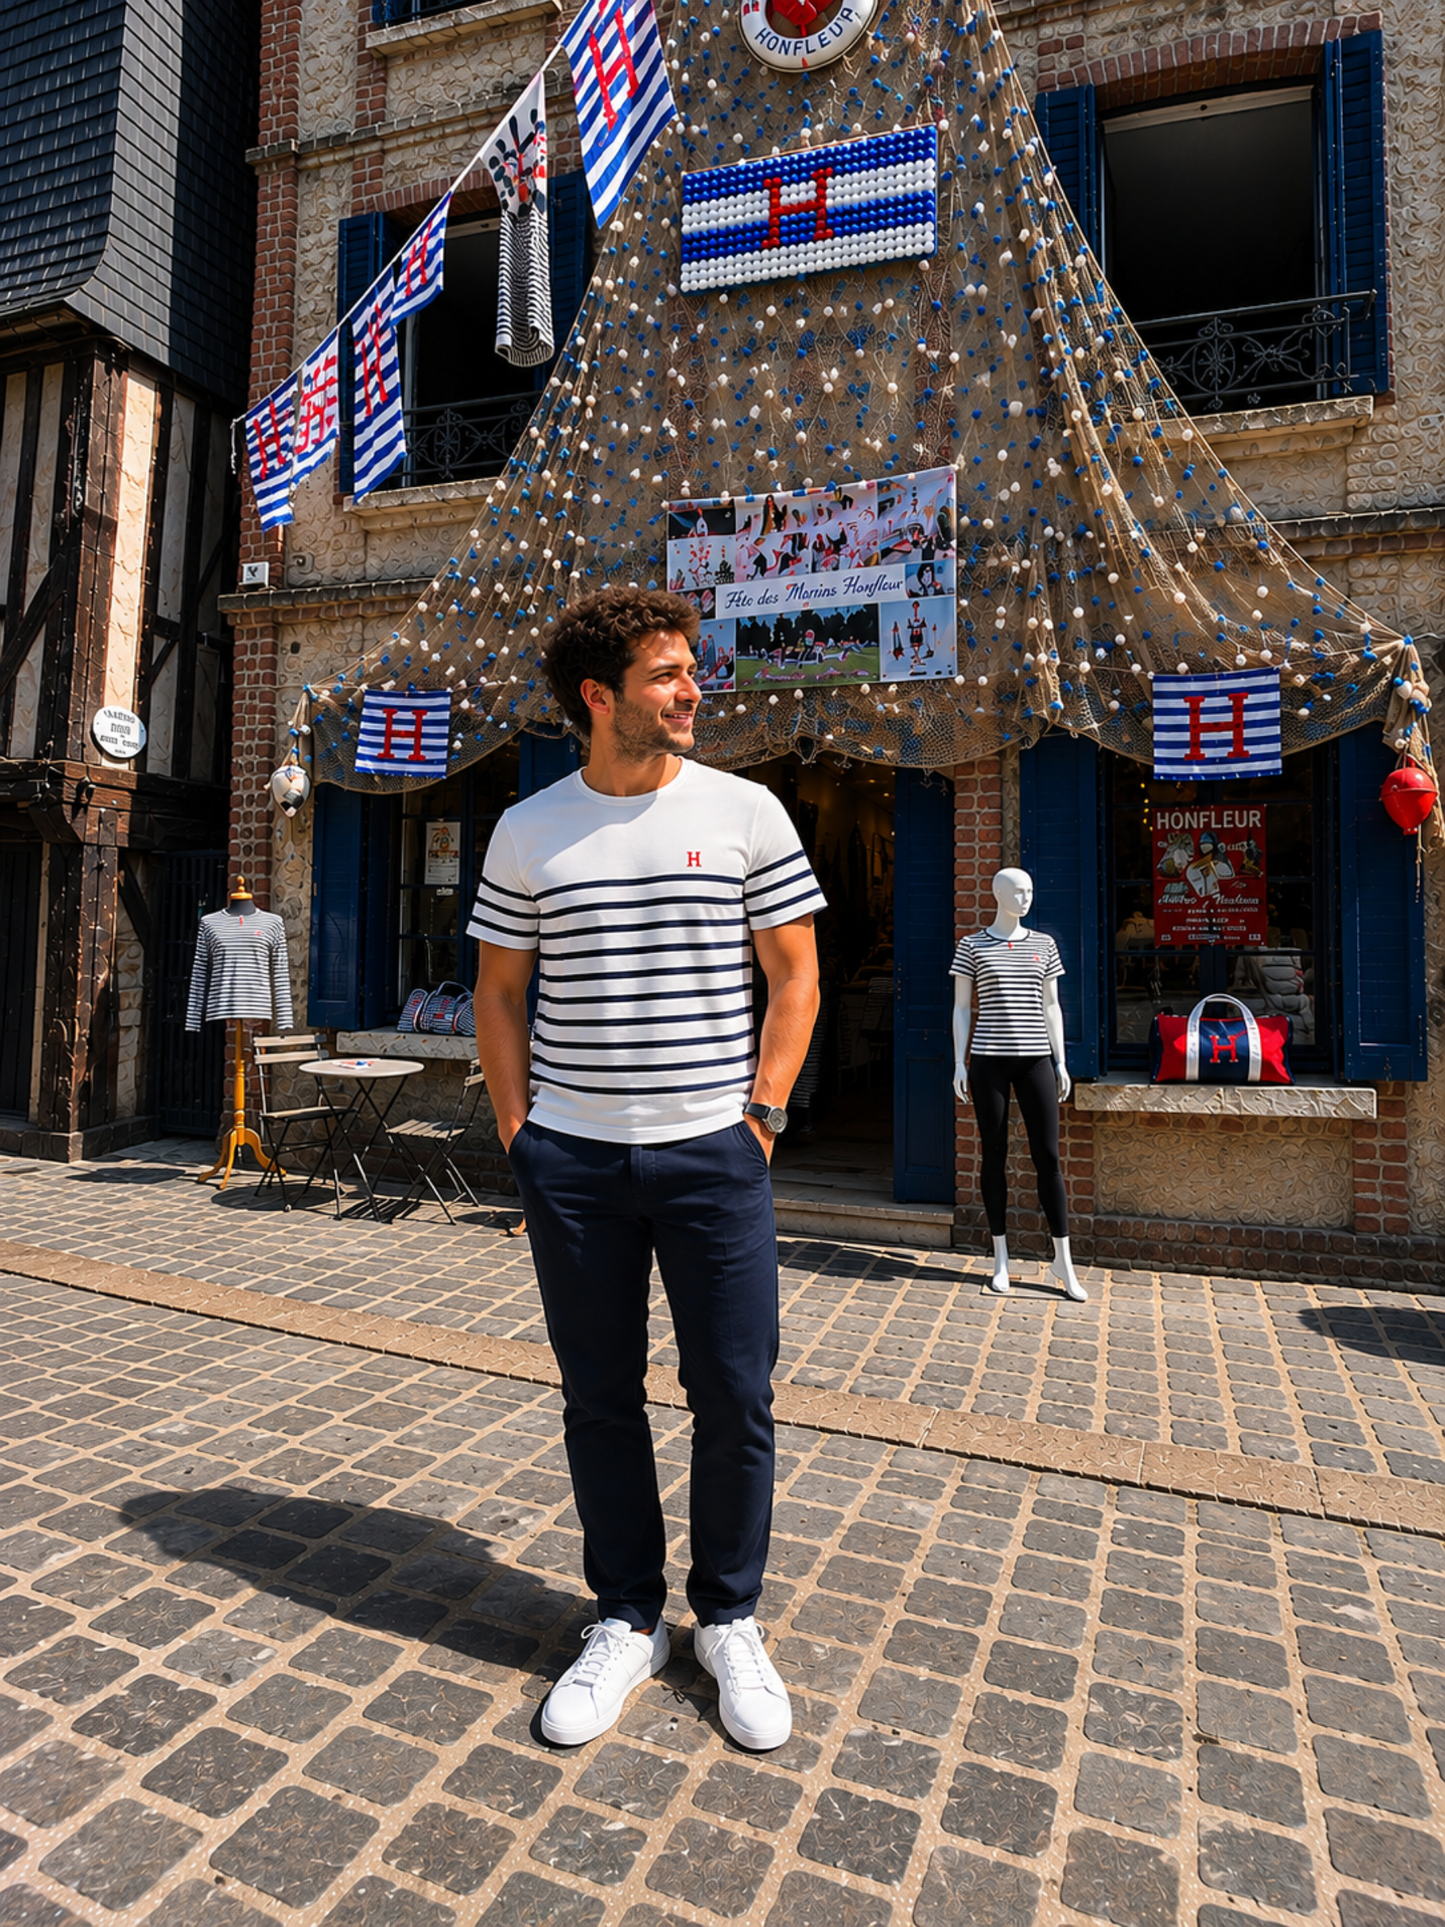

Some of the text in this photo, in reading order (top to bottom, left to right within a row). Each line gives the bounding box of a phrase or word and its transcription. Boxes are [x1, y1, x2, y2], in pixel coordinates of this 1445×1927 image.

[761, 167, 834, 249] H
[377, 708, 428, 761] H
[1183, 692, 1250, 761] H
[1156, 809, 1262, 830] HONFLEUR
[686, 851, 702, 868] H
[1209, 1035, 1239, 1063] H
